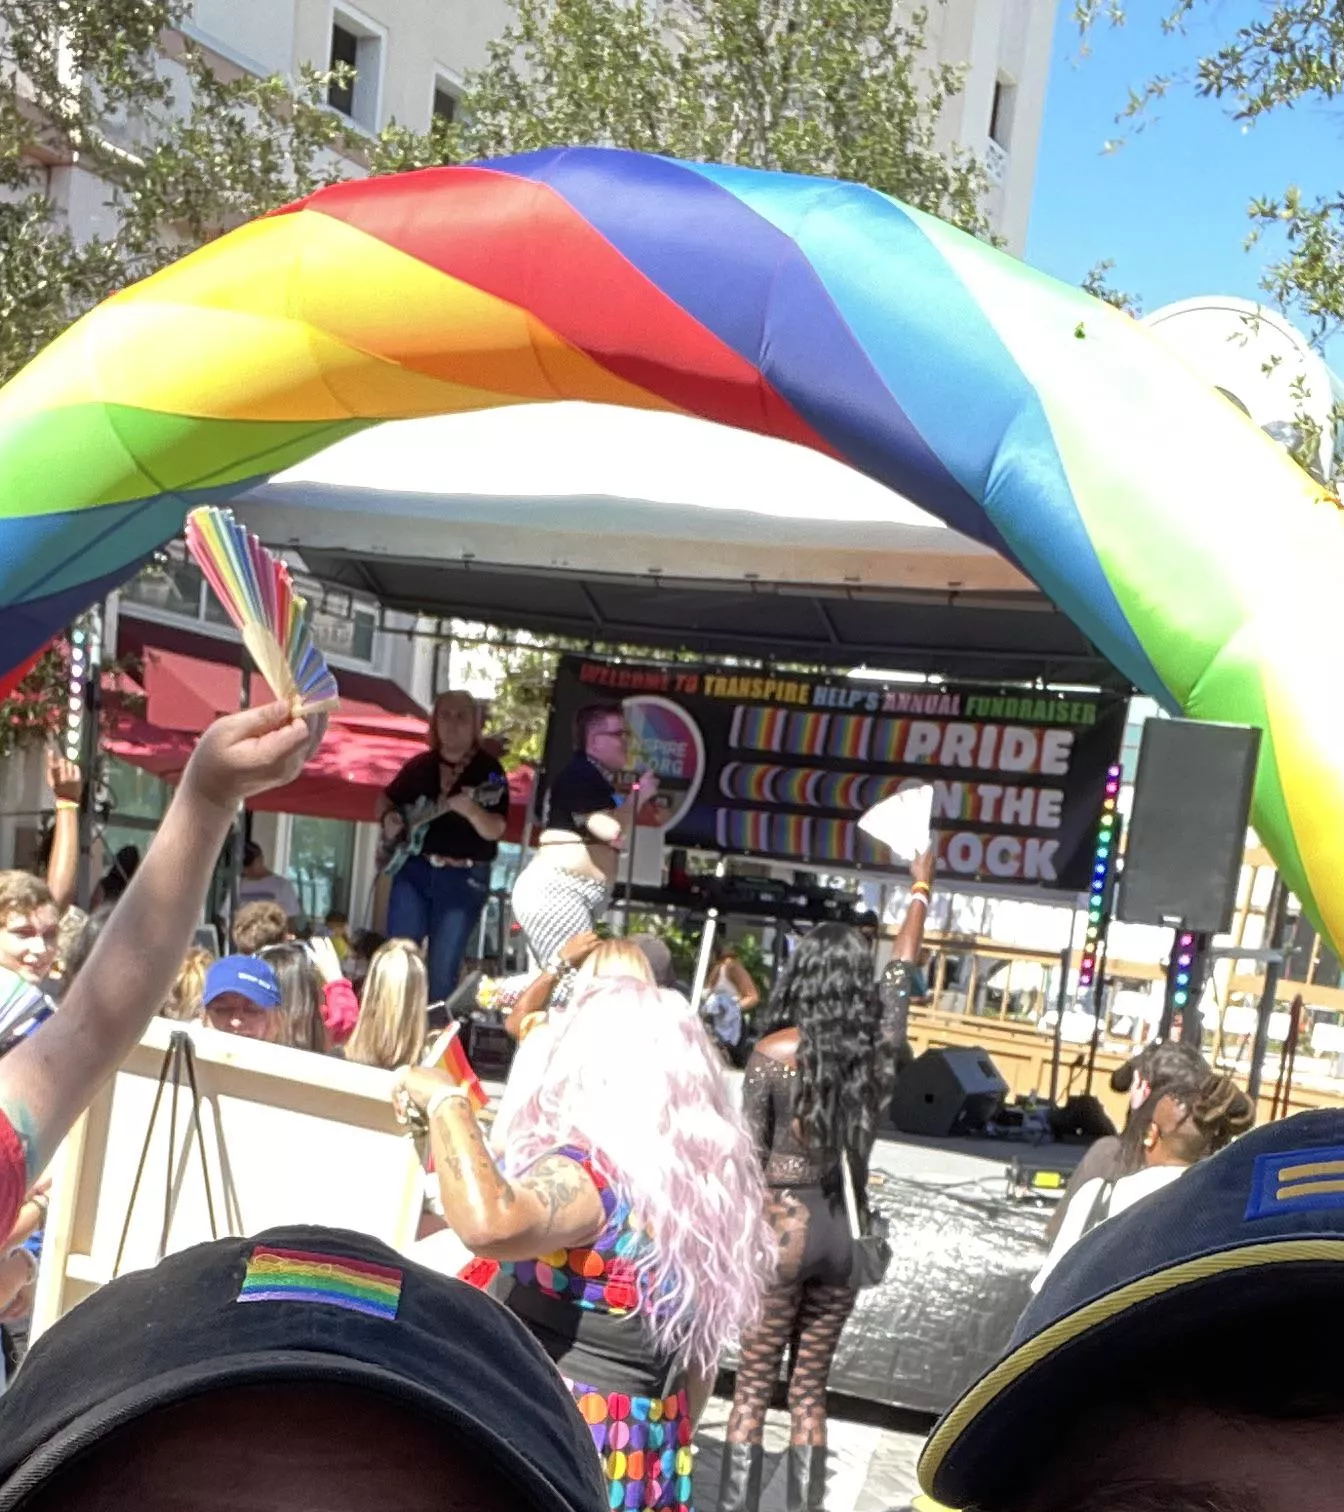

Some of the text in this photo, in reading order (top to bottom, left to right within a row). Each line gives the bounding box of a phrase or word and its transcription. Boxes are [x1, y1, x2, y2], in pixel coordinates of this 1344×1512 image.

[704, 675, 811, 704] TRANSPIRE
[813, 685, 879, 710] HELP'S
[881, 693, 960, 716] ANNUAL
[964, 697, 1096, 725] FUNDRAISER
[902, 721, 1075, 776] PRIDE
[976, 784, 1064, 828] THE
[889, 830, 1060, 880] LOCK
